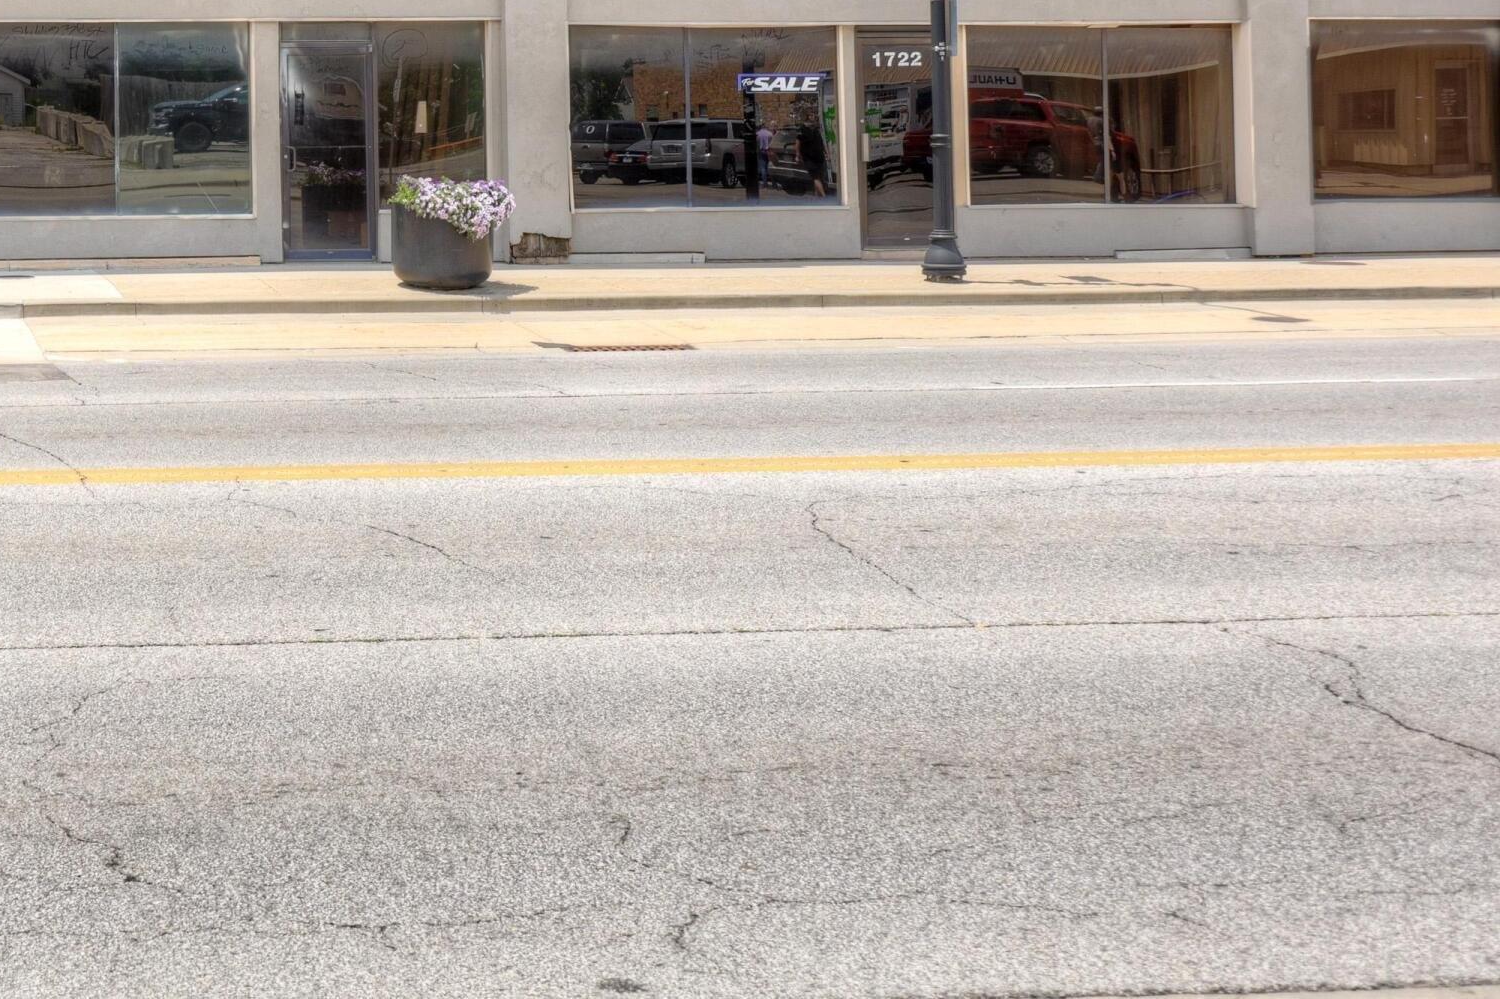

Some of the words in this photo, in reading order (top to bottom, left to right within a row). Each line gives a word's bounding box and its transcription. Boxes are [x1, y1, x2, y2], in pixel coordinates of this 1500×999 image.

[872, 51, 922, 67] 1722
[741, 78, 755, 87] For
[751, 76, 820, 92] SALE
